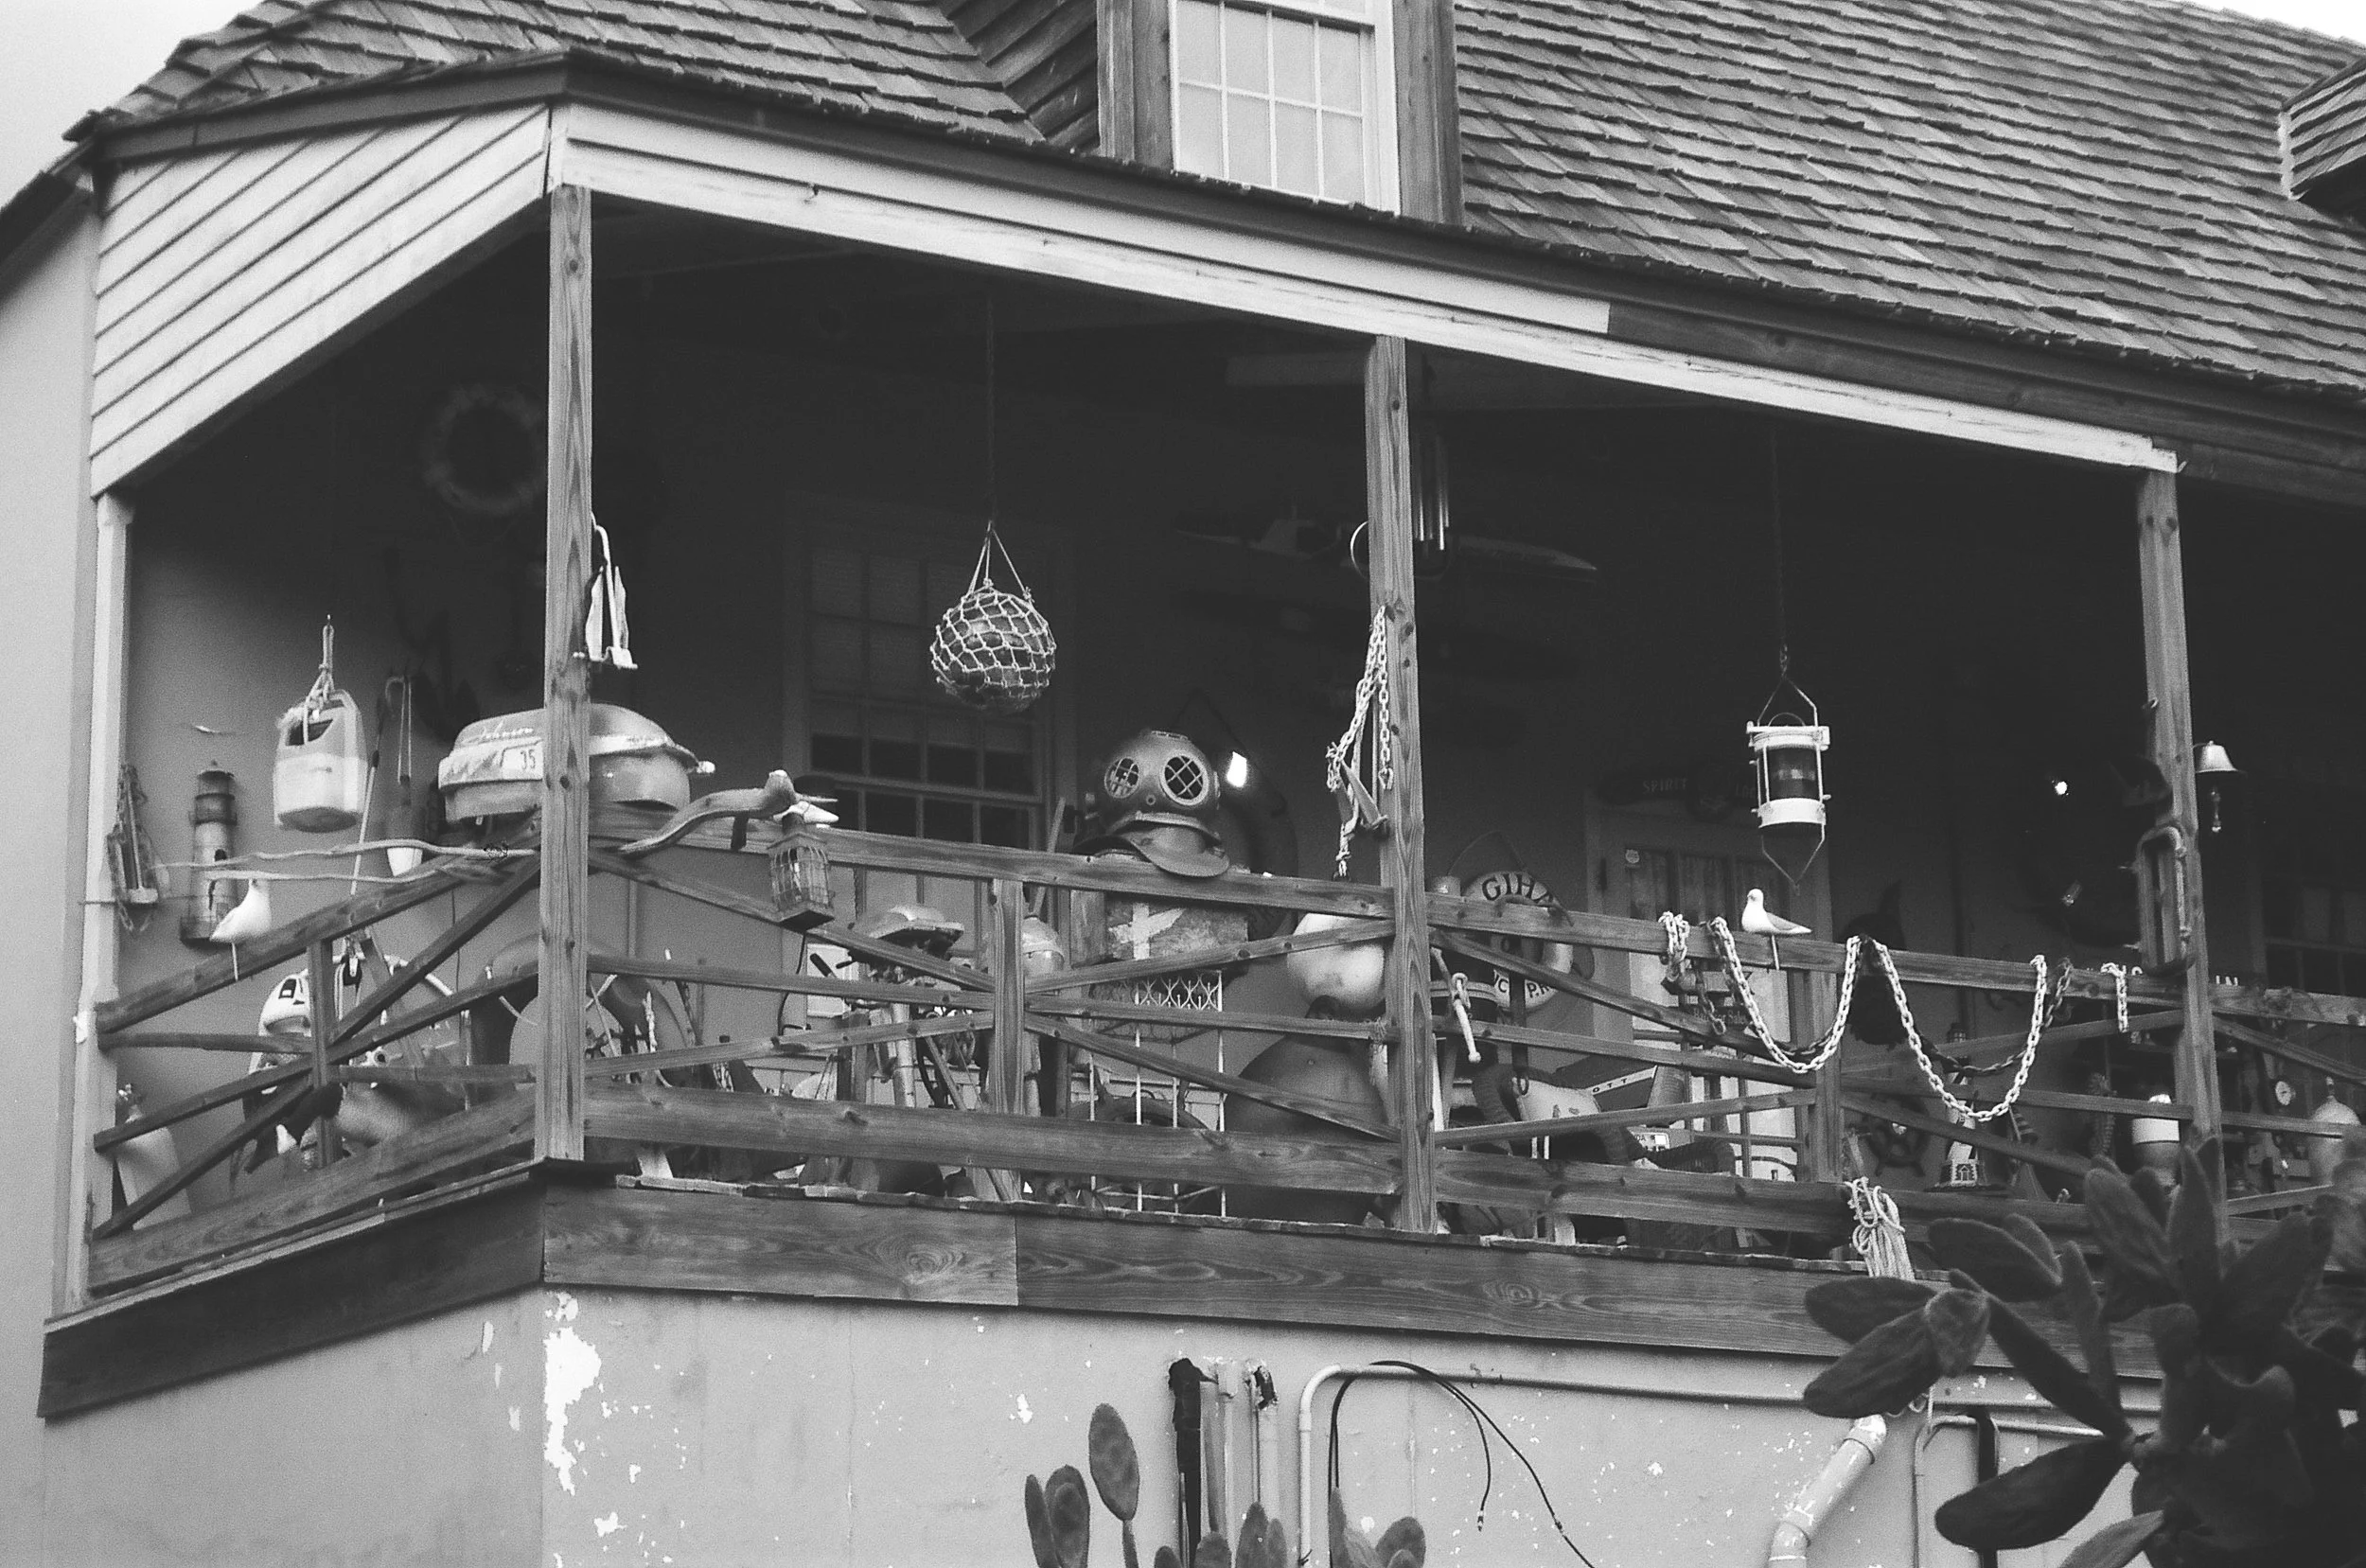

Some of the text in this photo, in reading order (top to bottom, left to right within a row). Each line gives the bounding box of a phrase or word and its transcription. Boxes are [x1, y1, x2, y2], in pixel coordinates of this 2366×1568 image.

[462, 720, 534, 744] Johnson
[520, 749, 537, 770] 35
[1642, 777, 1688, 795] SPIRIT
